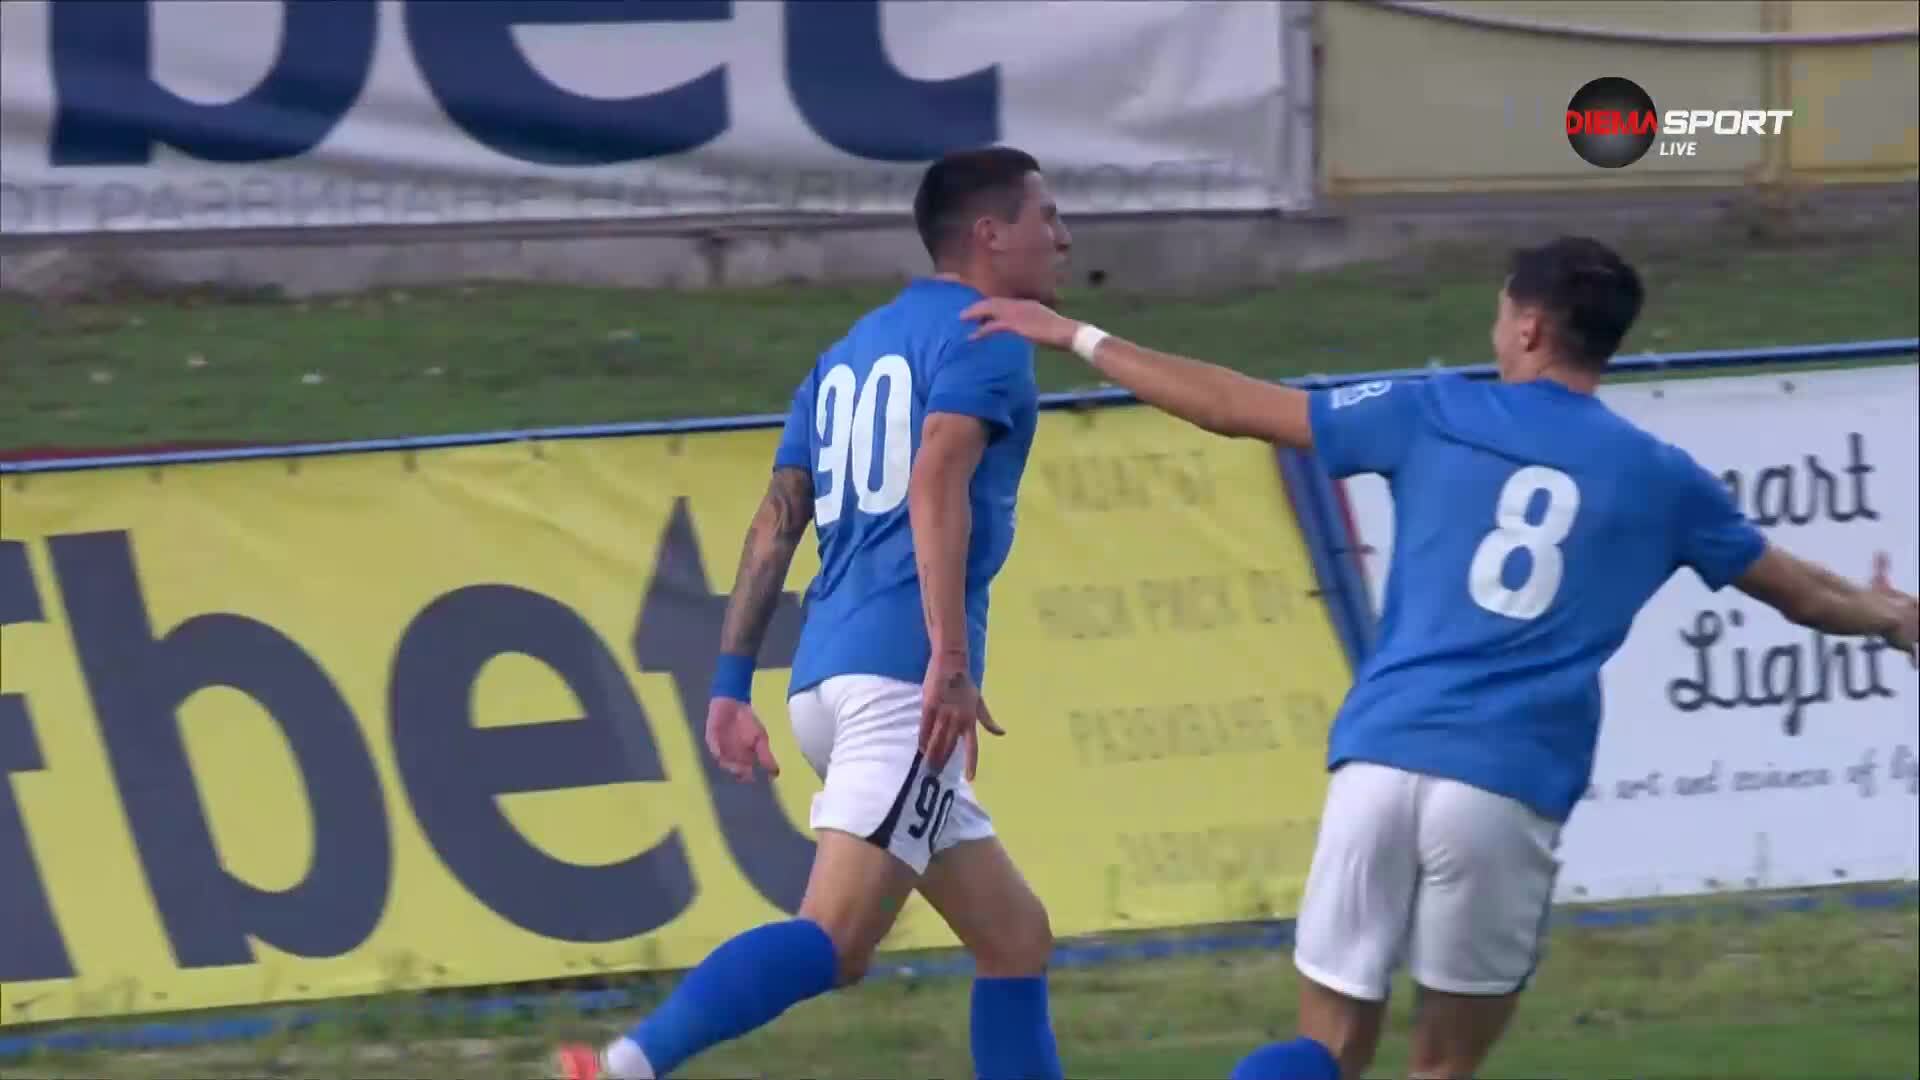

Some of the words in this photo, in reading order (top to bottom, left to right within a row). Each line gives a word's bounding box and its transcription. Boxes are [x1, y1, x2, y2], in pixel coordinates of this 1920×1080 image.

[814, 354, 912, 526] 90
[1722, 431, 1880, 526] art
[1468, 464, 1581, 620] 8
[1668, 610, 1897, 736] Light
[908, 777, 956, 855] 90
